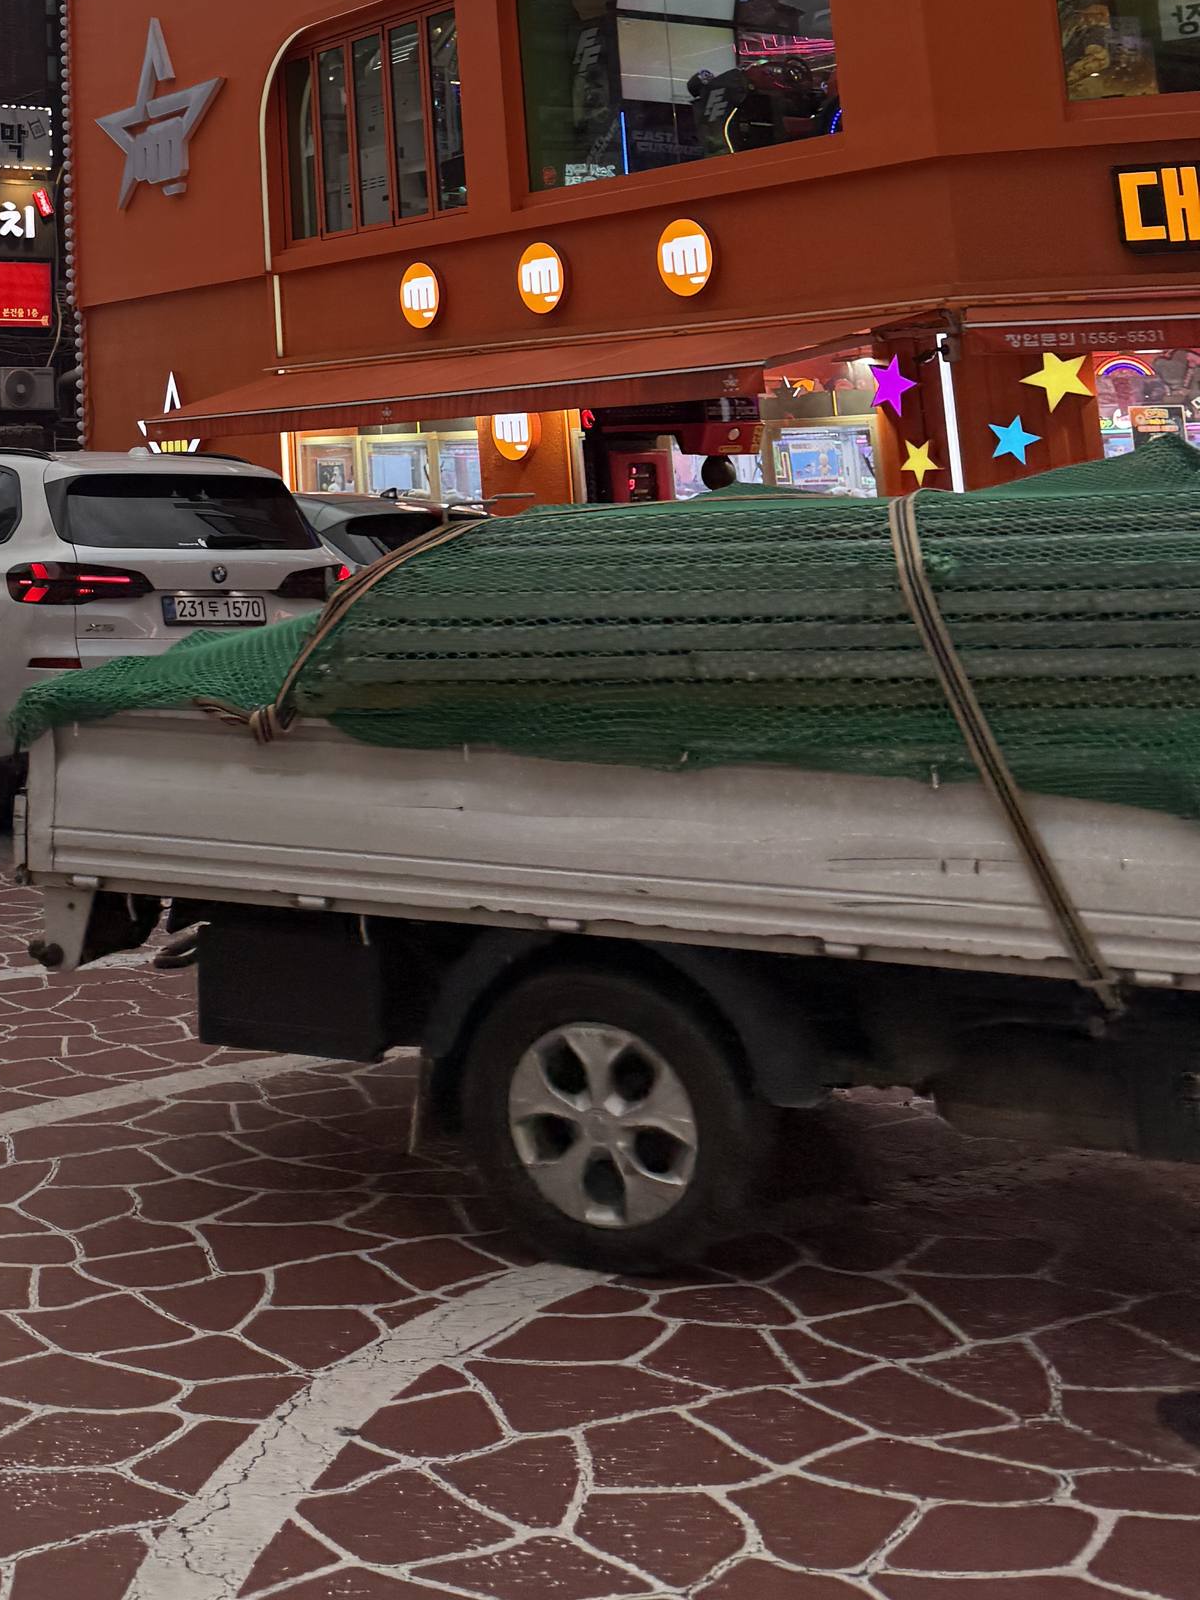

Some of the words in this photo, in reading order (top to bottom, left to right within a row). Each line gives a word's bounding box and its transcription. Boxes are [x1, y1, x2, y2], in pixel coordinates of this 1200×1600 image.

[1005, 332, 1076, 347] 창업문의
[177, 599, 219, 619] 231두
[224, 599, 261, 618] 1570
